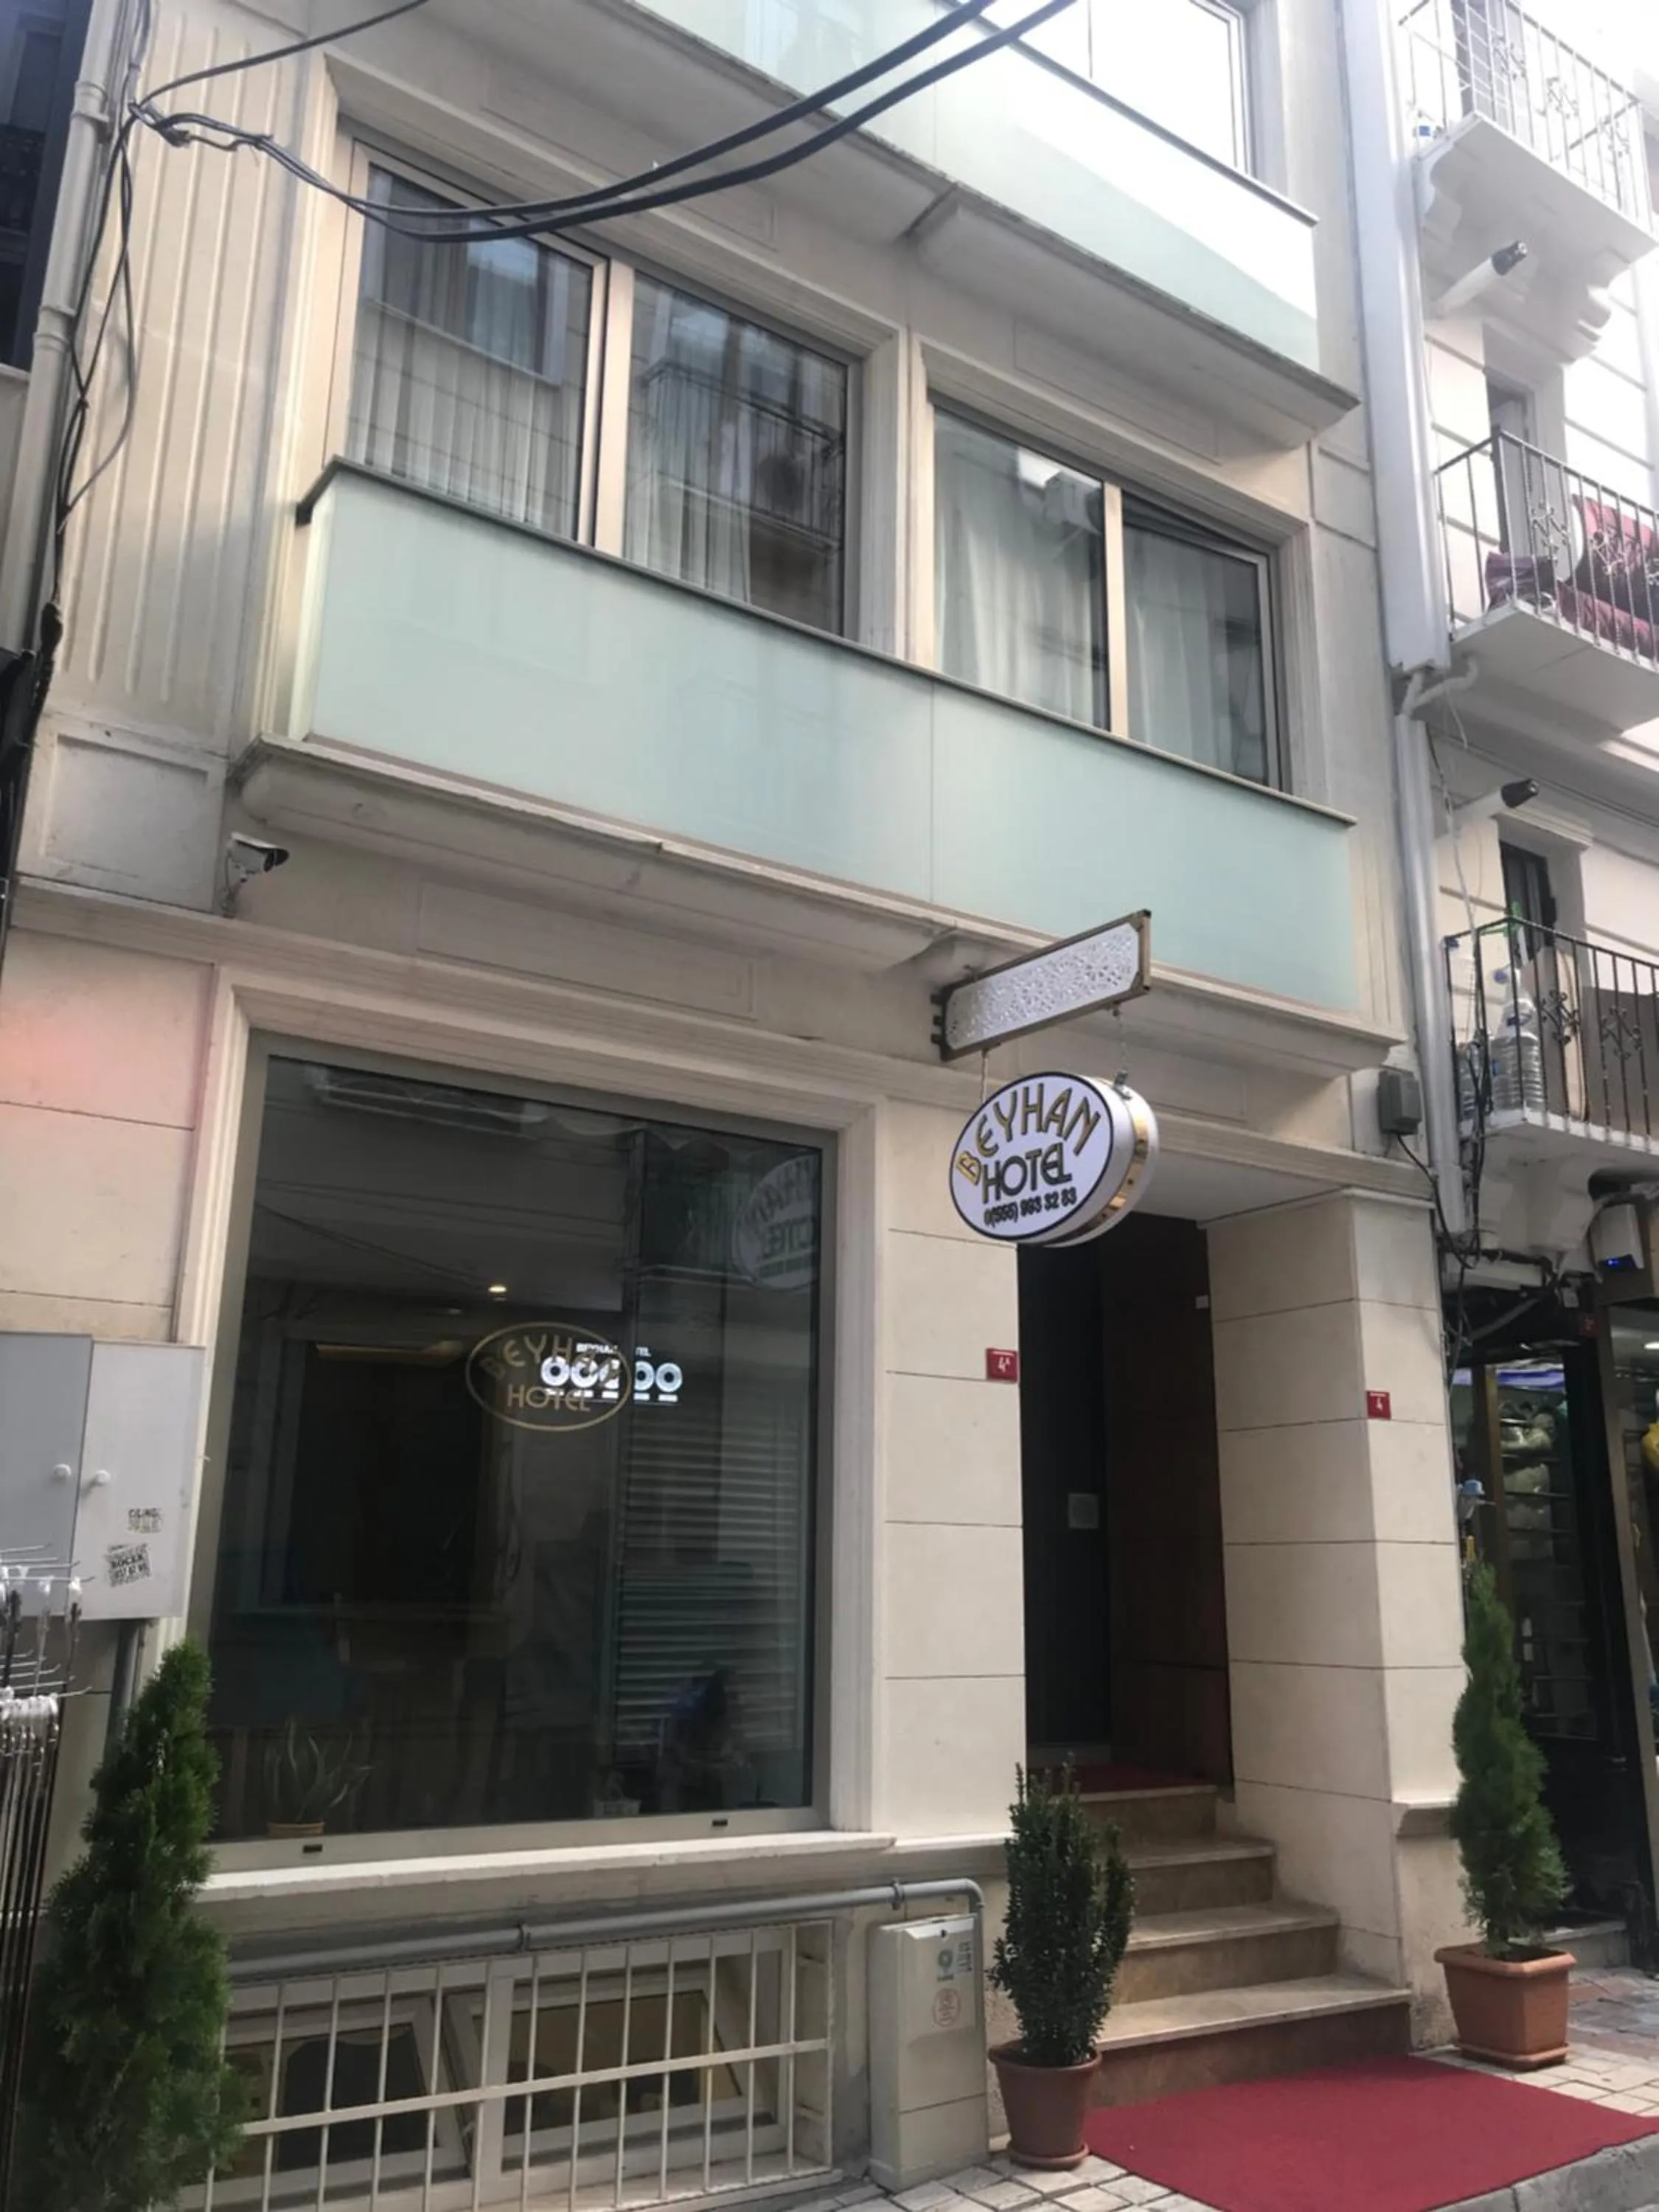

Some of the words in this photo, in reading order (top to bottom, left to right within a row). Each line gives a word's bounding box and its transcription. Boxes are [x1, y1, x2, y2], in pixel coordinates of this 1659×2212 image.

[956, 1082, 1102, 1186] BEYHAN
[981, 1142, 1073, 1204] HOTEL
[507, 1383, 591, 1411] HOTEL
